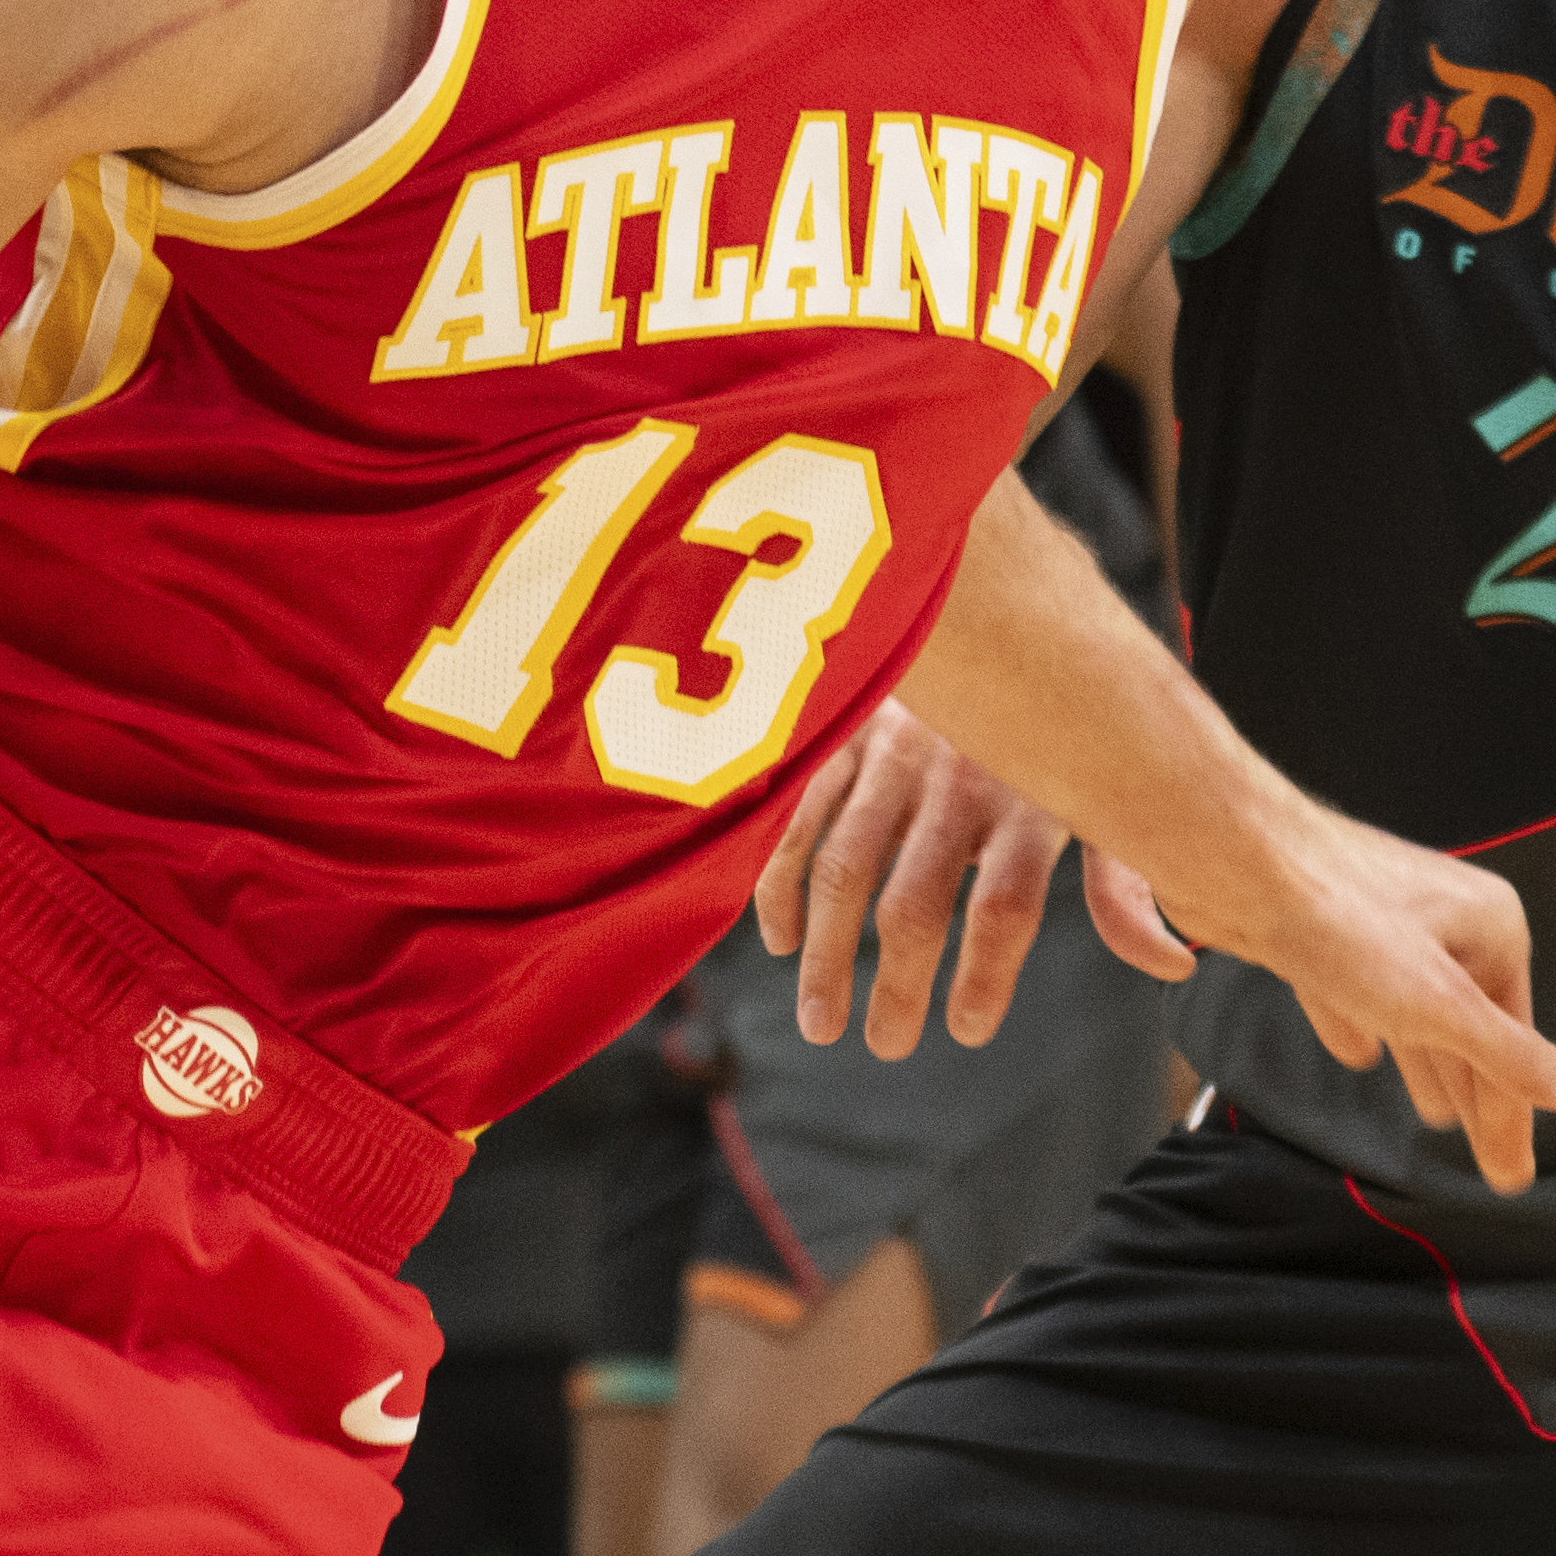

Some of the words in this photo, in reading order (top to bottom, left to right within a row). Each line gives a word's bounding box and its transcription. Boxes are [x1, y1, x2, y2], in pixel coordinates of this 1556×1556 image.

[1384, 93, 1499, 173] the
[369, 109, 1104, 390] ATLANTA
[1392, 227, 1478, 276] OF
[383, 416, 894, 809] 13
[134, 1006, 264, 1115] HAWKS
